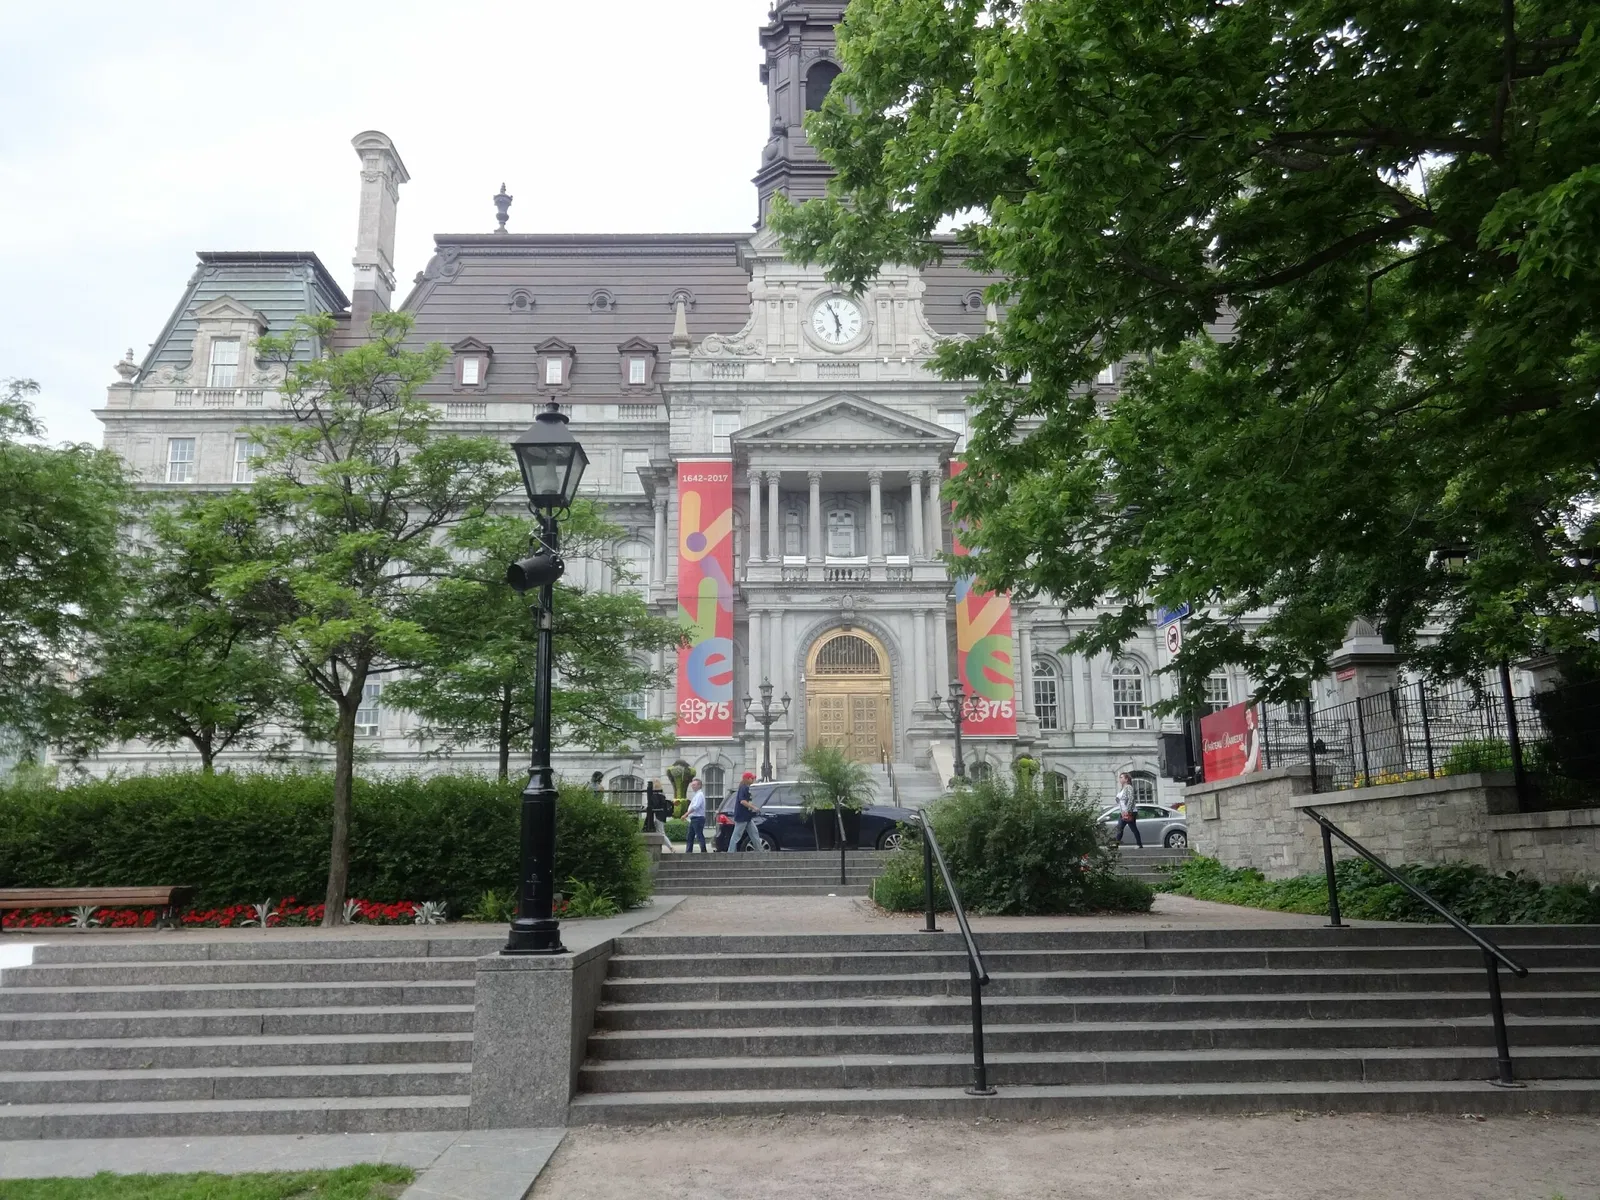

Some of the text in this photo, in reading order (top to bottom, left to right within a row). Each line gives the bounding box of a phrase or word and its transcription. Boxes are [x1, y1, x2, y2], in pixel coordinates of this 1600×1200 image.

[682, 474, 729, 482] 1642-2017
[699, 701, 730, 720] 375
[980, 700, 1013, 719] 375
